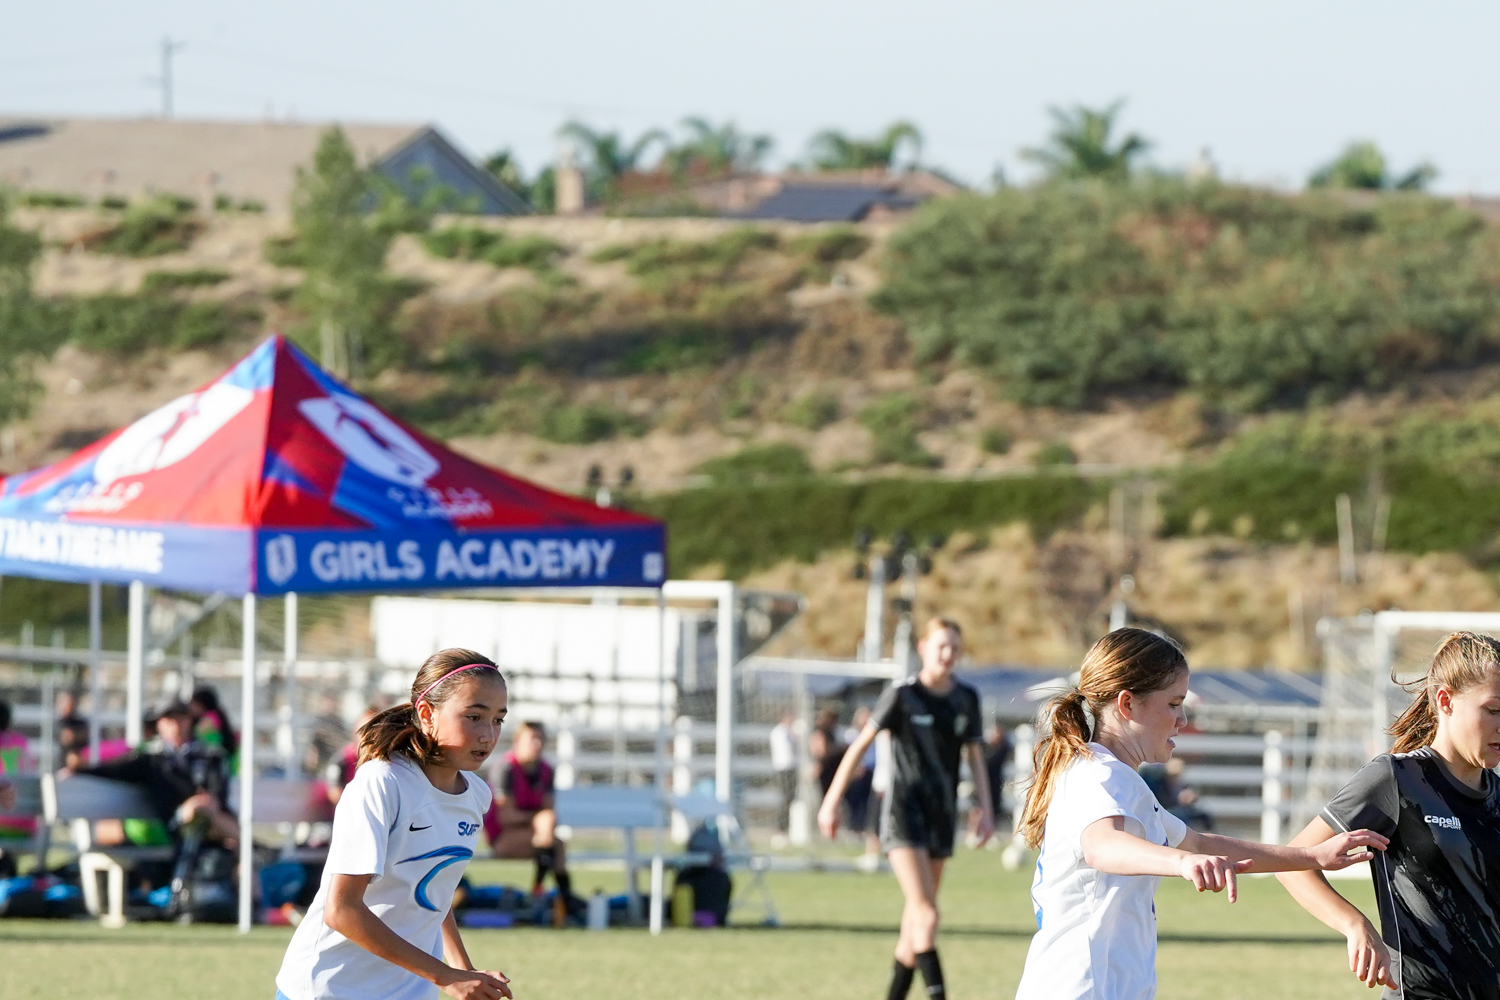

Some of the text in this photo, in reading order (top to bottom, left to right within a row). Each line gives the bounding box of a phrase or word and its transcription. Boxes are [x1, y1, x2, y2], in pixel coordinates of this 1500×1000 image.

[311, 540, 613, 580] GIRLS ACADEMY
[1424, 815, 1461, 827] capelli
